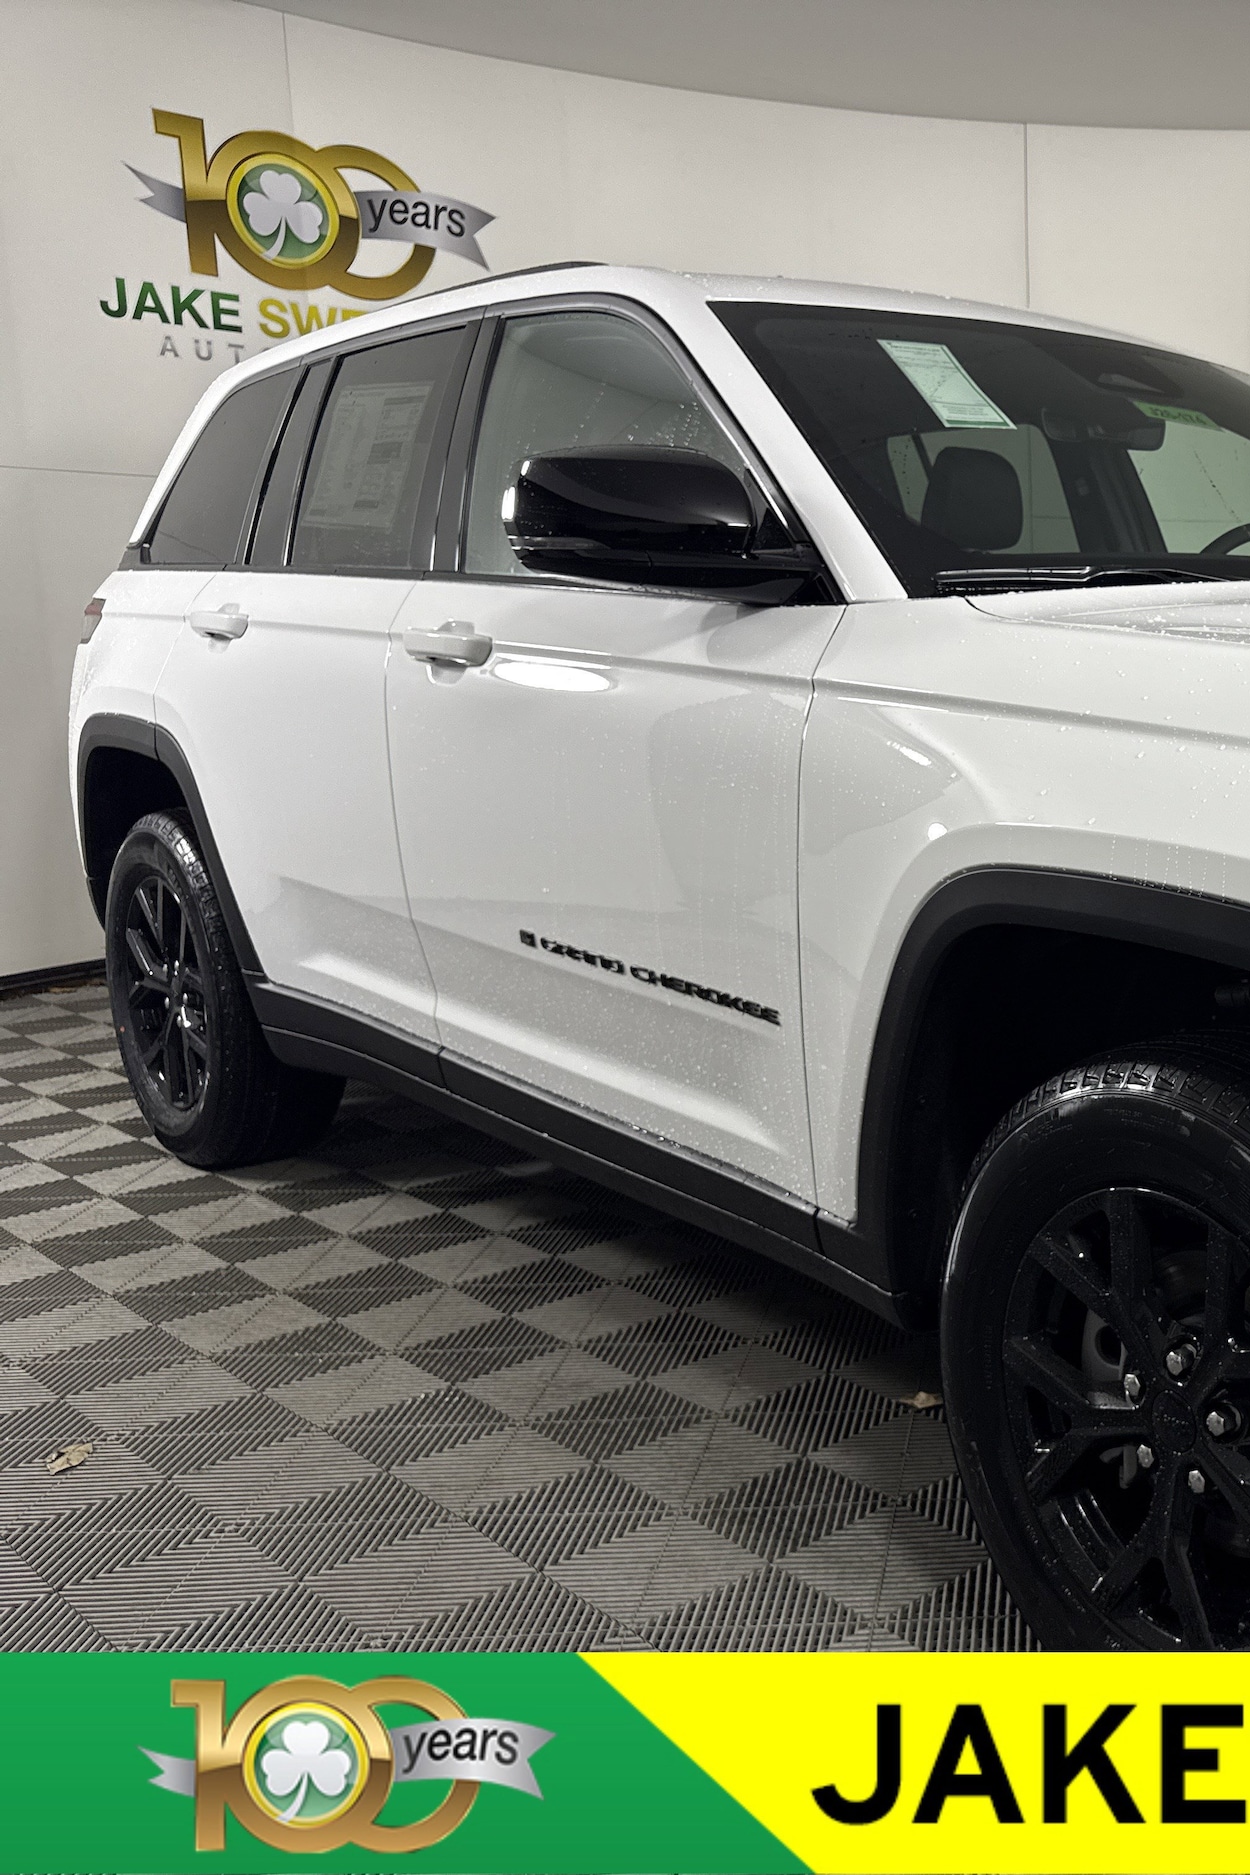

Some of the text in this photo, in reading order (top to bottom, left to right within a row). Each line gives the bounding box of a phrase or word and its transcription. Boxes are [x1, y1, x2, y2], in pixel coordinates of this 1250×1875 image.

[367, 196, 466, 238] years
[100, 277, 243, 333] JAKE
[160, 336, 275, 364] AUT
[629, 963, 782, 1026] CHEROKEE
